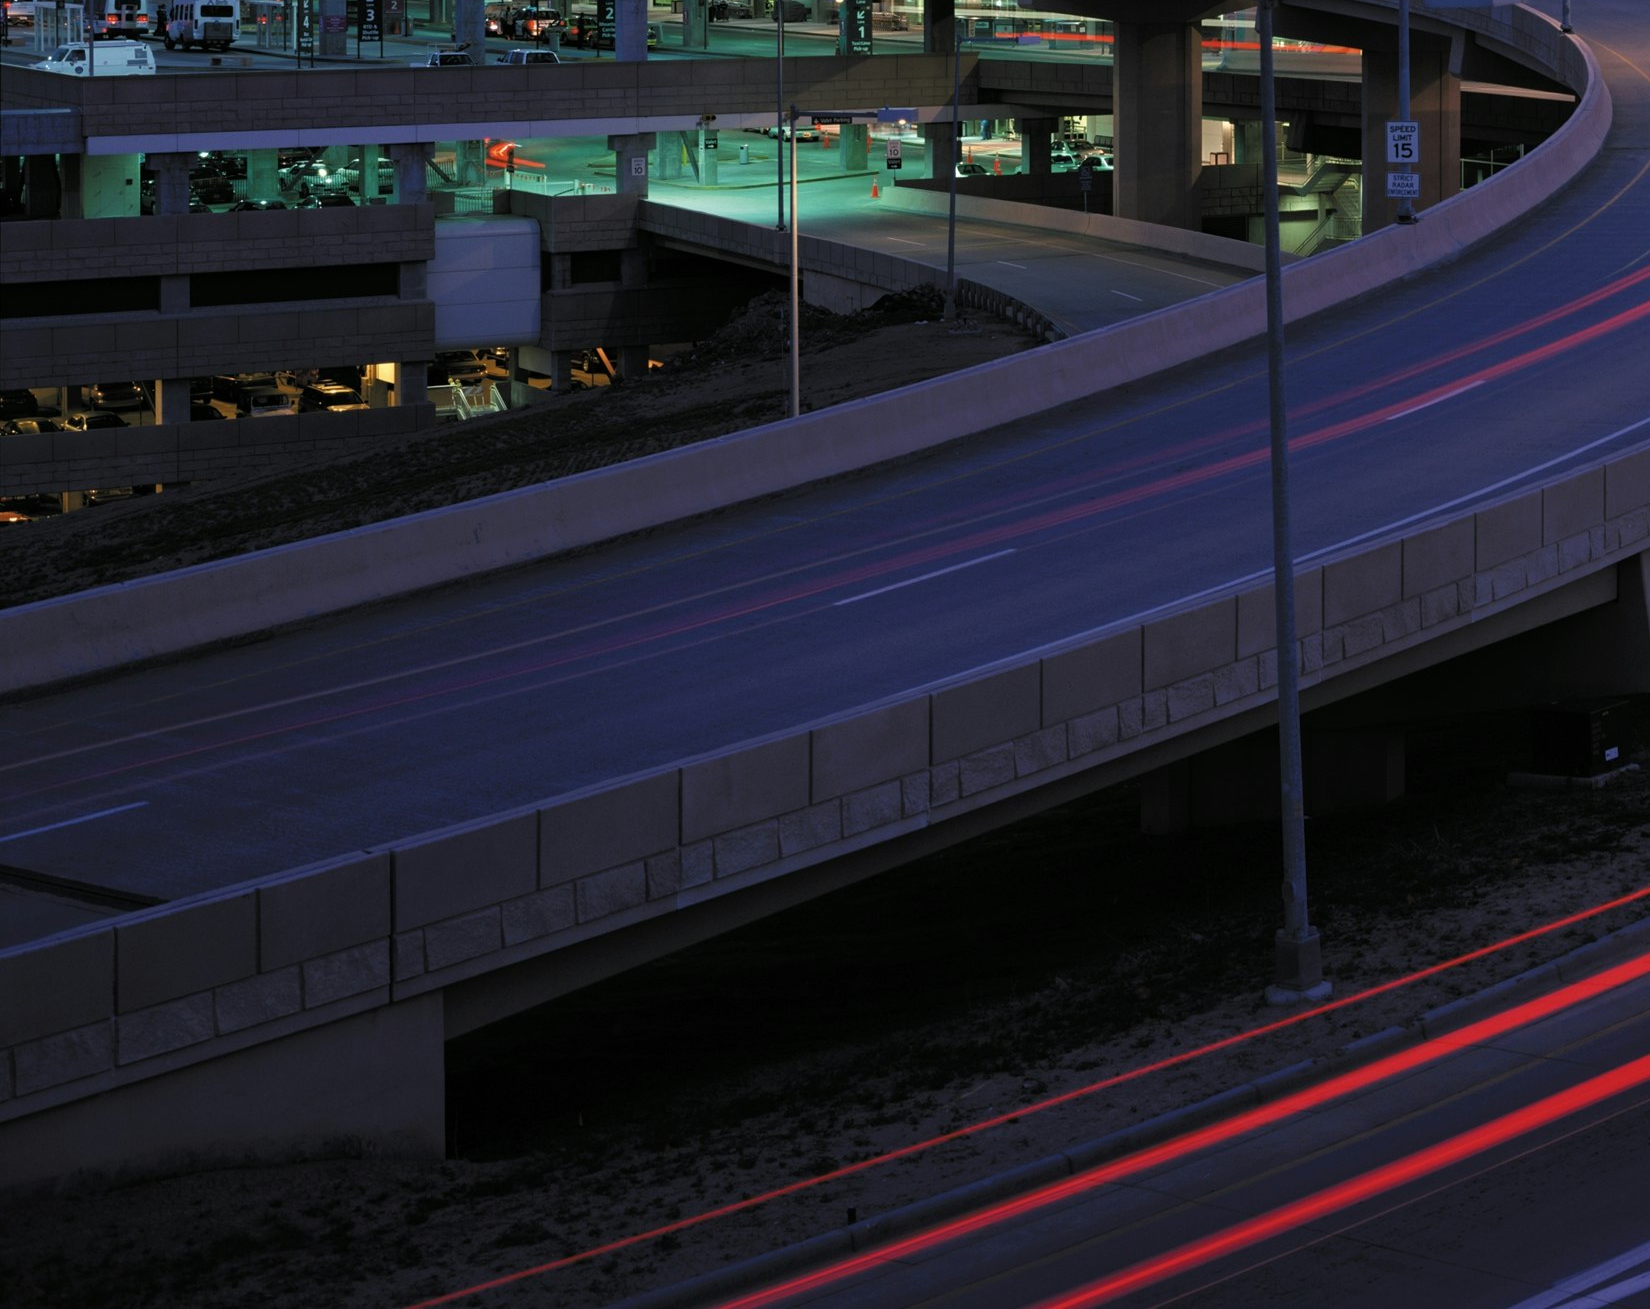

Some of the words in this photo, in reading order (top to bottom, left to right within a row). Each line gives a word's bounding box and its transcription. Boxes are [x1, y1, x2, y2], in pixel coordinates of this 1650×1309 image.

[391, 0, 398, 9] 2
[366, 9, 375, 21] 3
[605, 7, 614, 19] 2
[303, 15, 309, 28] 4
[858, 26, 865, 38] 1
[1393, 143, 1413, 158] 15
